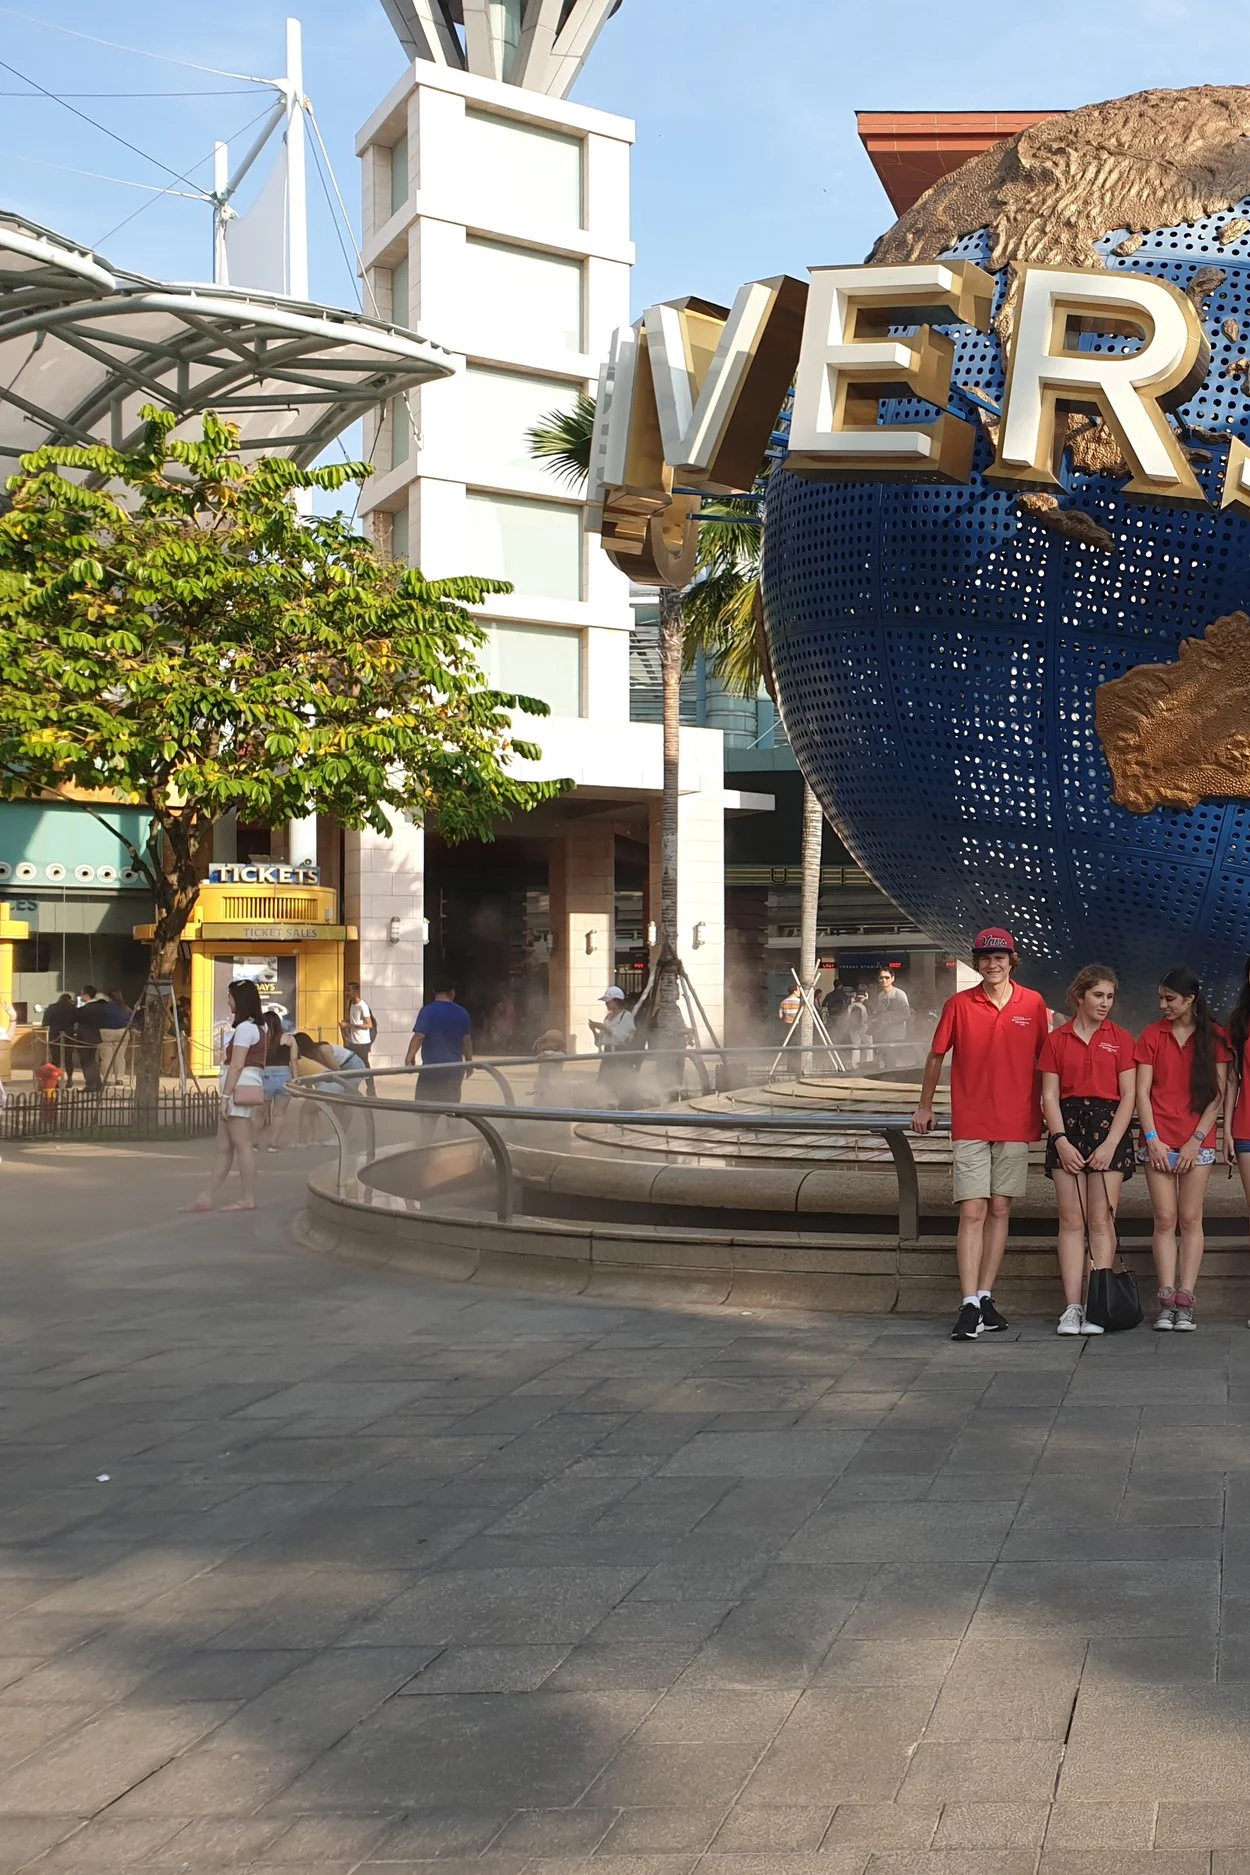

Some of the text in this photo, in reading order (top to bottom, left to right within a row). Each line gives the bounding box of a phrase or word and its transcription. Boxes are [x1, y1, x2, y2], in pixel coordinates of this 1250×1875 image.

[218, 866, 318, 884] TICKETS
[243, 927, 318, 938] TICKET SALES
